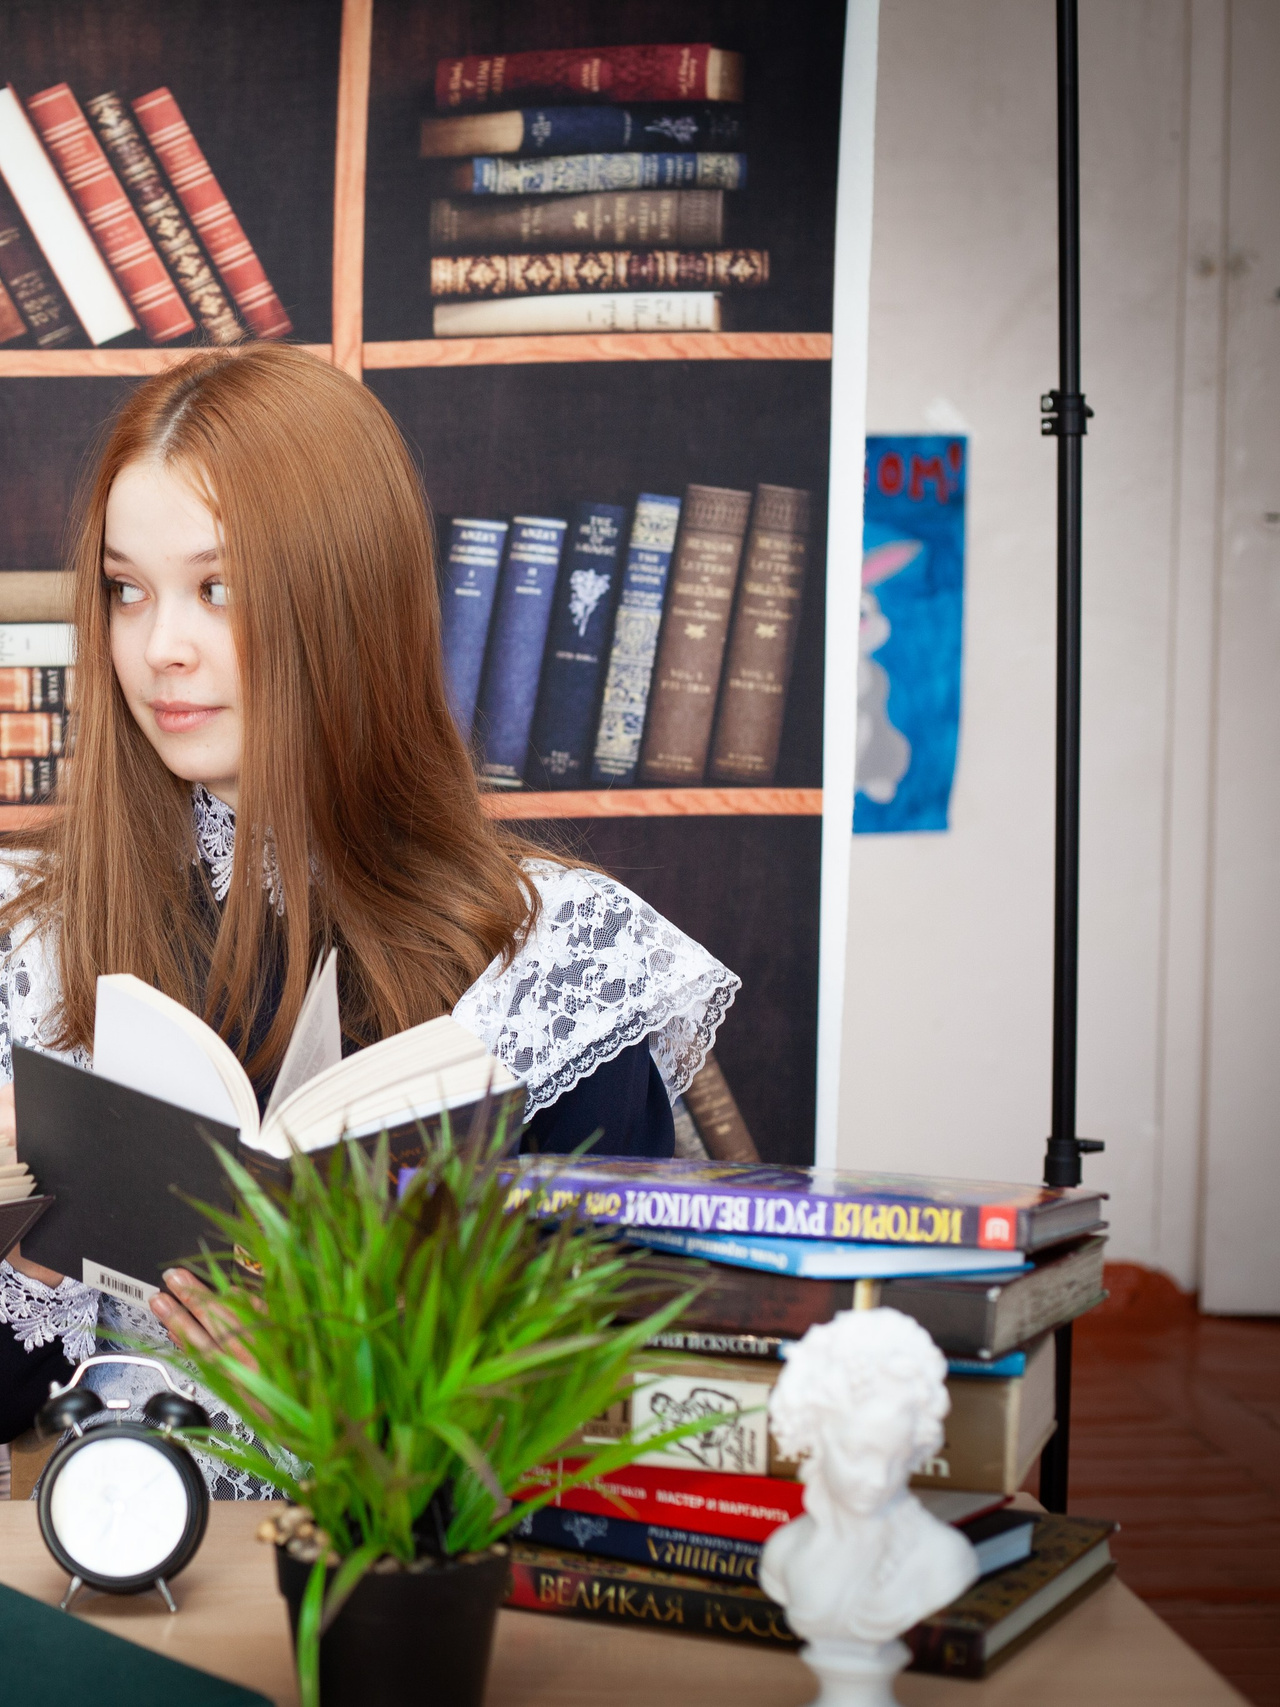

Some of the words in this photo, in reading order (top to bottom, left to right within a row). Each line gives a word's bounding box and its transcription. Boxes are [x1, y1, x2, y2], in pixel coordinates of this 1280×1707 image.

[864, 441, 963, 505] ОМ!
[620, 1190, 750, 1233] ВЕЛИКОЙ
[752, 1196, 829, 1236] РУСИ
[831, 1201, 964, 1244] ИСТОРИЯ
[655, 1487, 705, 1510] МАСТЕР
[718, 1498, 791, 1524] МАРГАРИТА
[645, 1537, 761, 1580] ОЛУШКА
[538, 1573, 685, 1625] ВЕЛИКАЯ
[704, 1602, 803, 1641] РОСС
